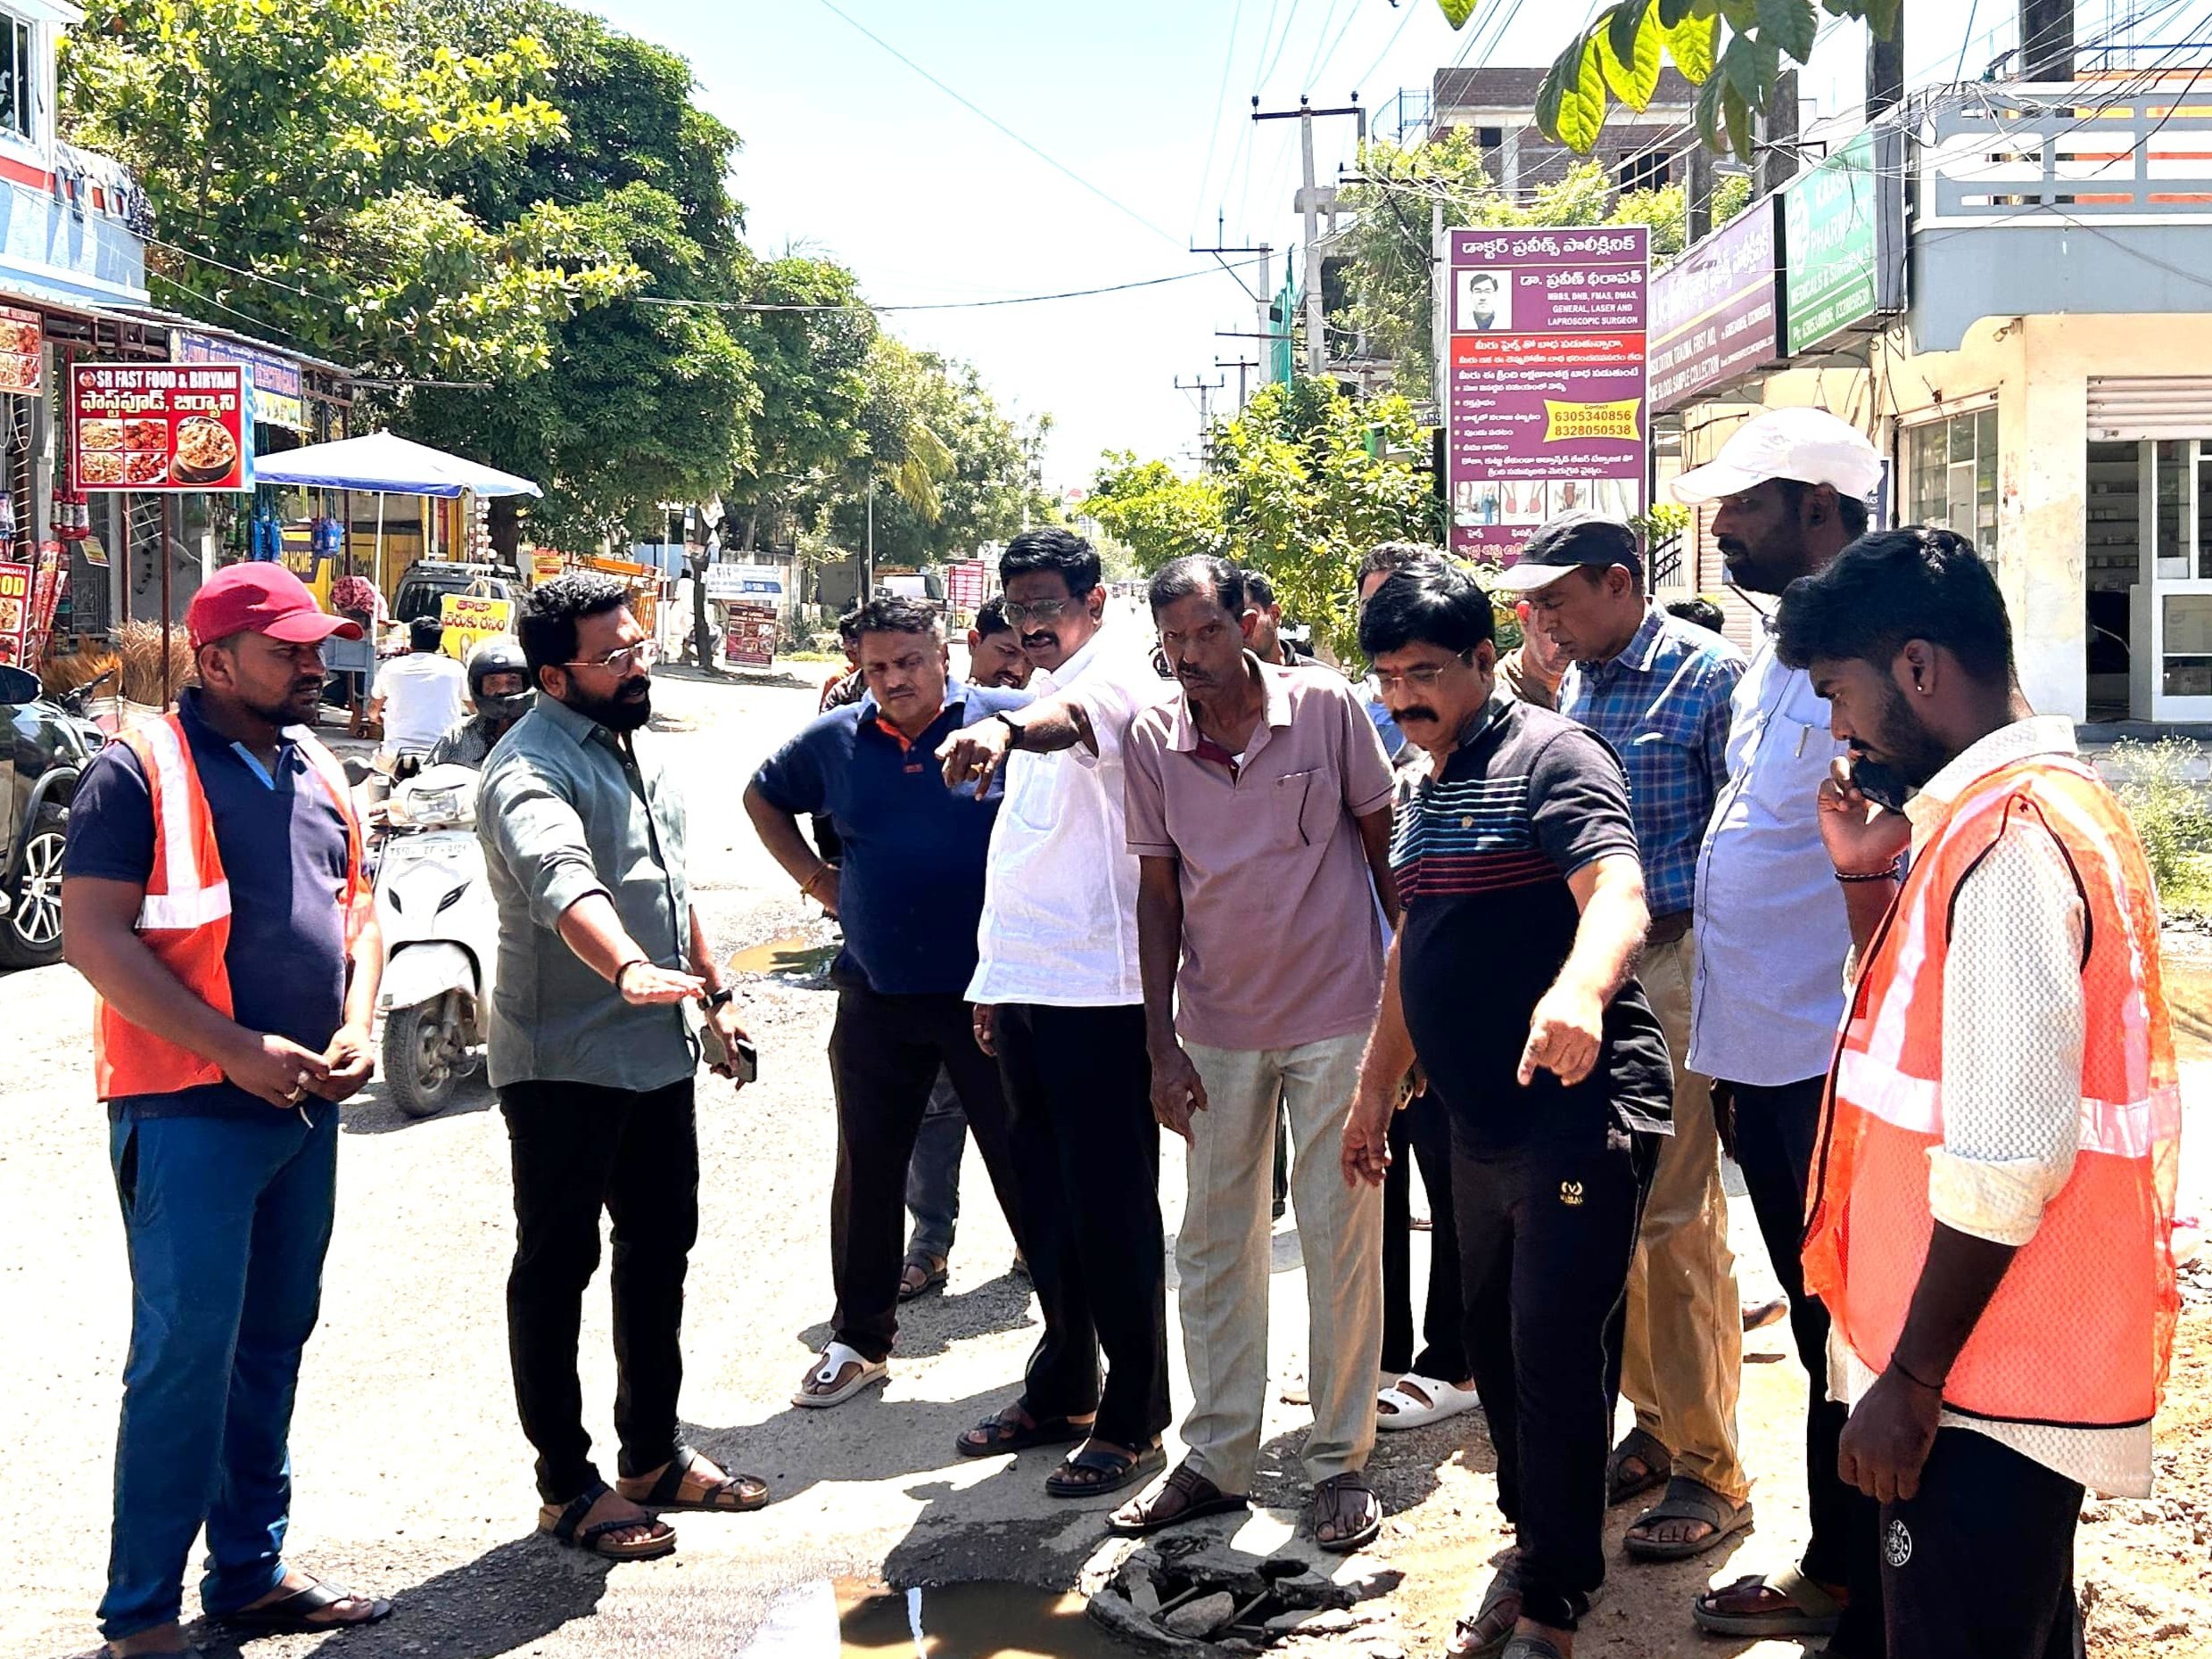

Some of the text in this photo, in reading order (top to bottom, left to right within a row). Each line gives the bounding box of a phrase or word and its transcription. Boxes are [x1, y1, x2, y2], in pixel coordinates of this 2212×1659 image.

[1591, 303, 1615, 313] LASER
[1616, 303, 1632, 312] AND
[1601, 316, 1638, 326] SURGEON
[96, 370, 236, 390] SR FAST FOOD & BIRYANI
[1555, 410, 1632, 422] 6305340856
[1555, 425, 1631, 436] 8328050538
[291, 550, 312, 573] HOME
